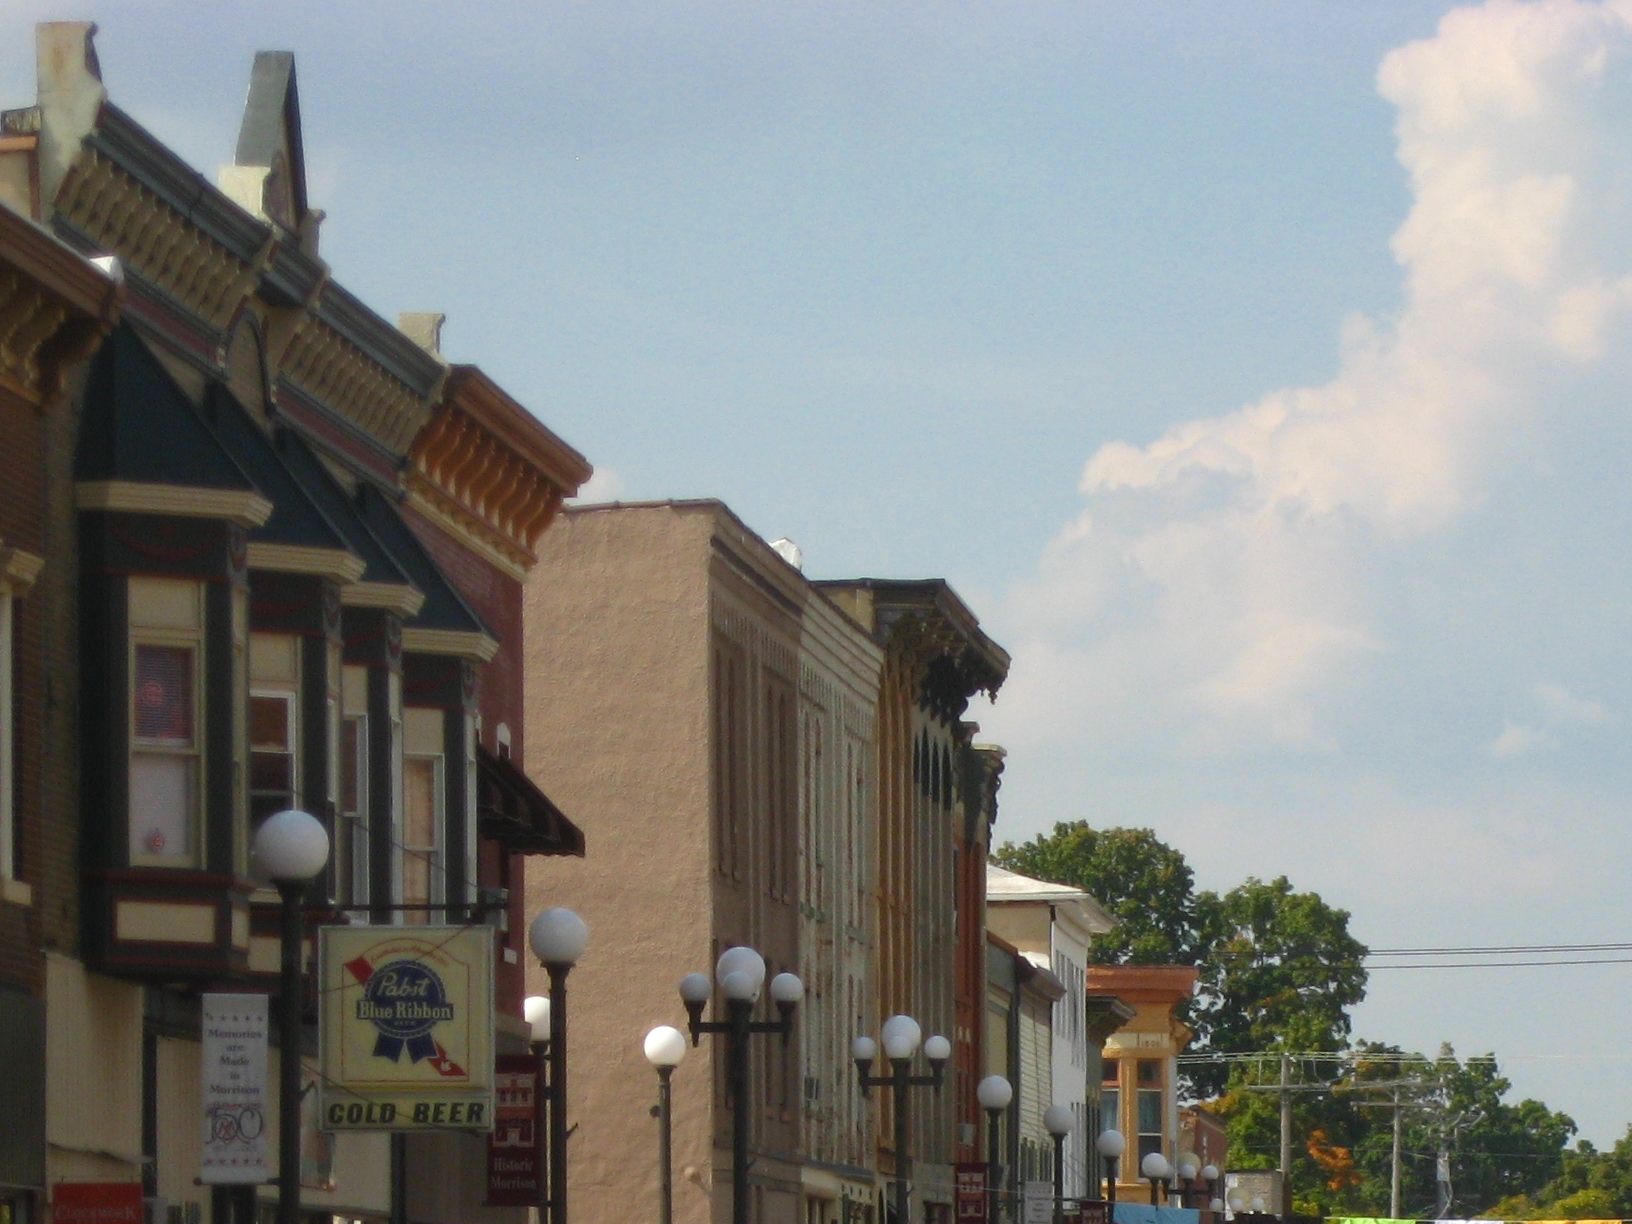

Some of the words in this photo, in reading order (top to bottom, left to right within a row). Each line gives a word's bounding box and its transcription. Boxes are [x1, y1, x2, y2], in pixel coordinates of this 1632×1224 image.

[377, 972, 432, 998] Pabst
[359, 1001, 393, 1020] Blue
[395, 1001, 453, 1020] Ribbon
[208, 1028, 263, 1040] Memories
[226, 1043, 245, 1051] are
[219, 1055, 250, 1066] Made
[209, 1084, 261, 1095] Morrison
[328, 1102, 397, 1125] COLD
[412, 1102, 486, 1125] BEER
[494, 1158, 533, 1172] Historic
[491, 1176, 537, 1190] Morrison
